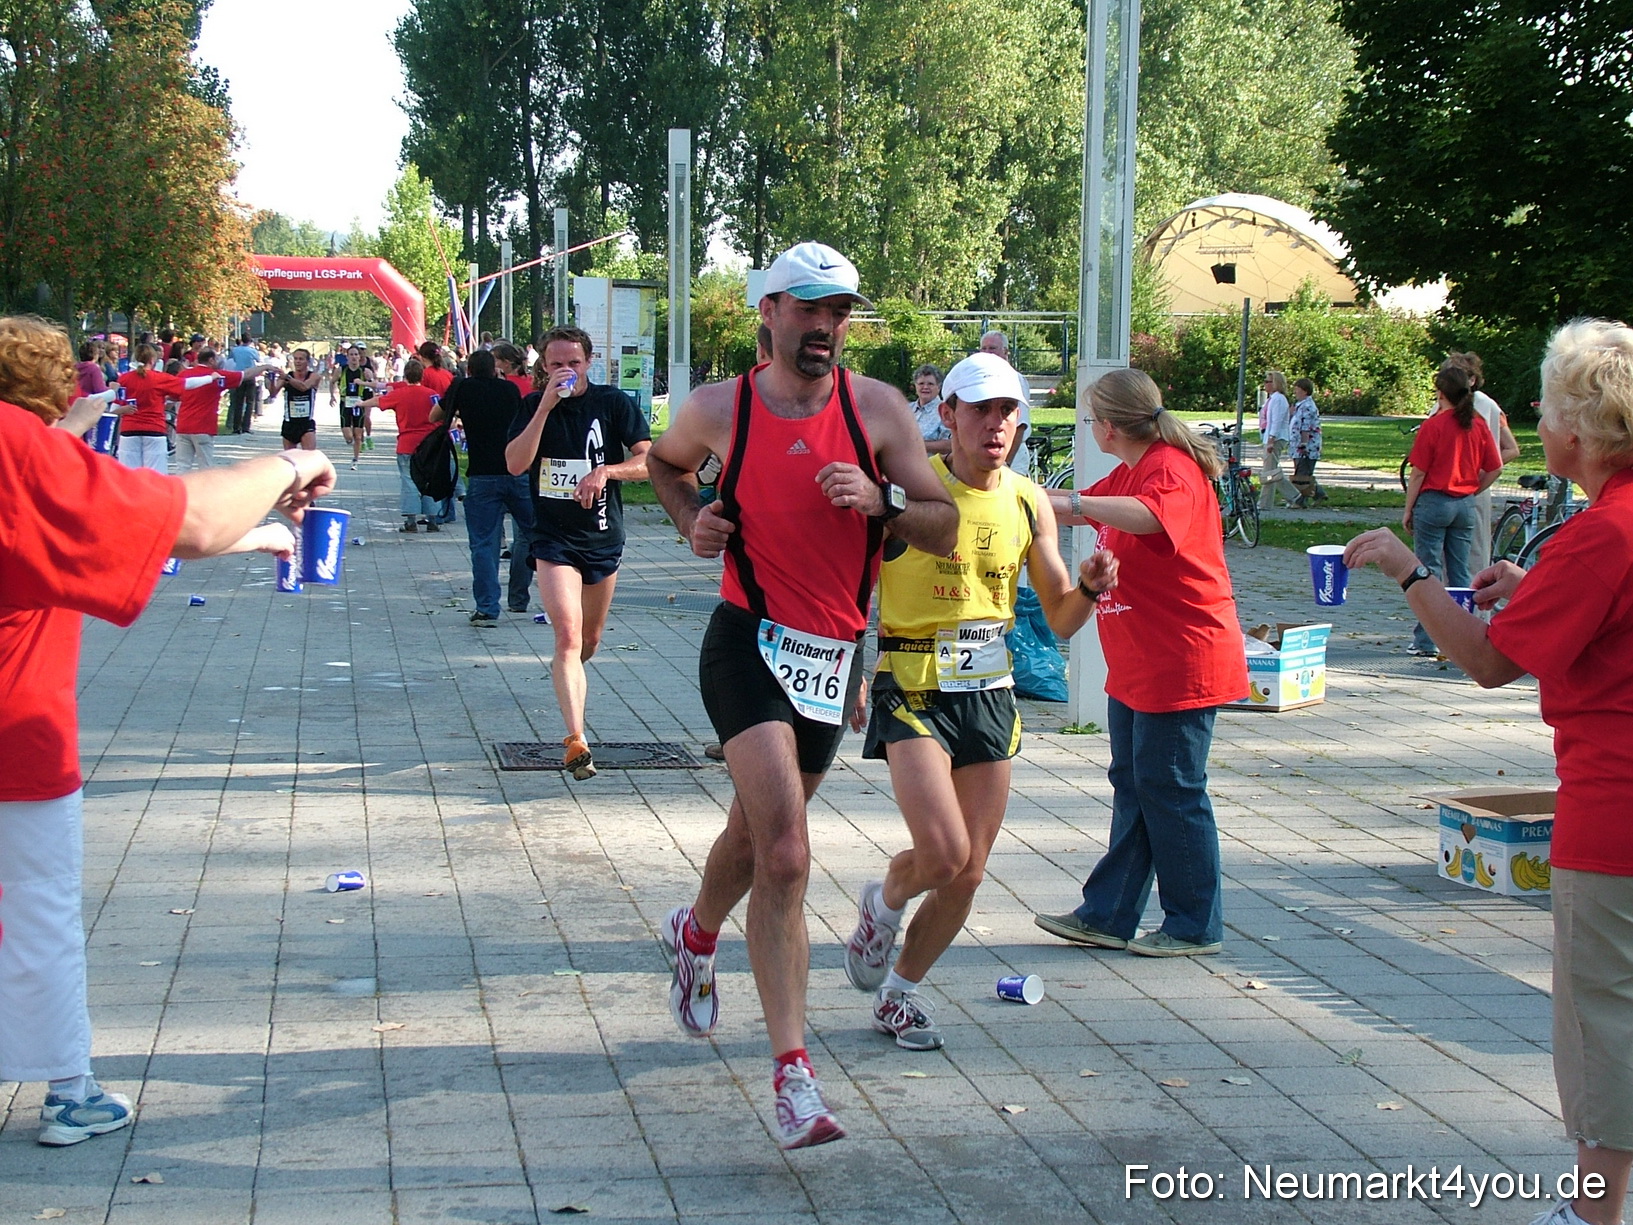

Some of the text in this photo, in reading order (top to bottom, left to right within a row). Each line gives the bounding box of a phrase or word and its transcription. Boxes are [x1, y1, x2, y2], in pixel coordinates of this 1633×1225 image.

[314, 269, 363, 279] LGS-Park
[550, 458, 567, 468] Ingo
[551, 474, 578, 487] 374
[933, 586, 971, 597] M & S
[780, 636, 835, 662] Richard
[940, 647, 974, 671] A 2
[778, 664, 841, 700] 2816
